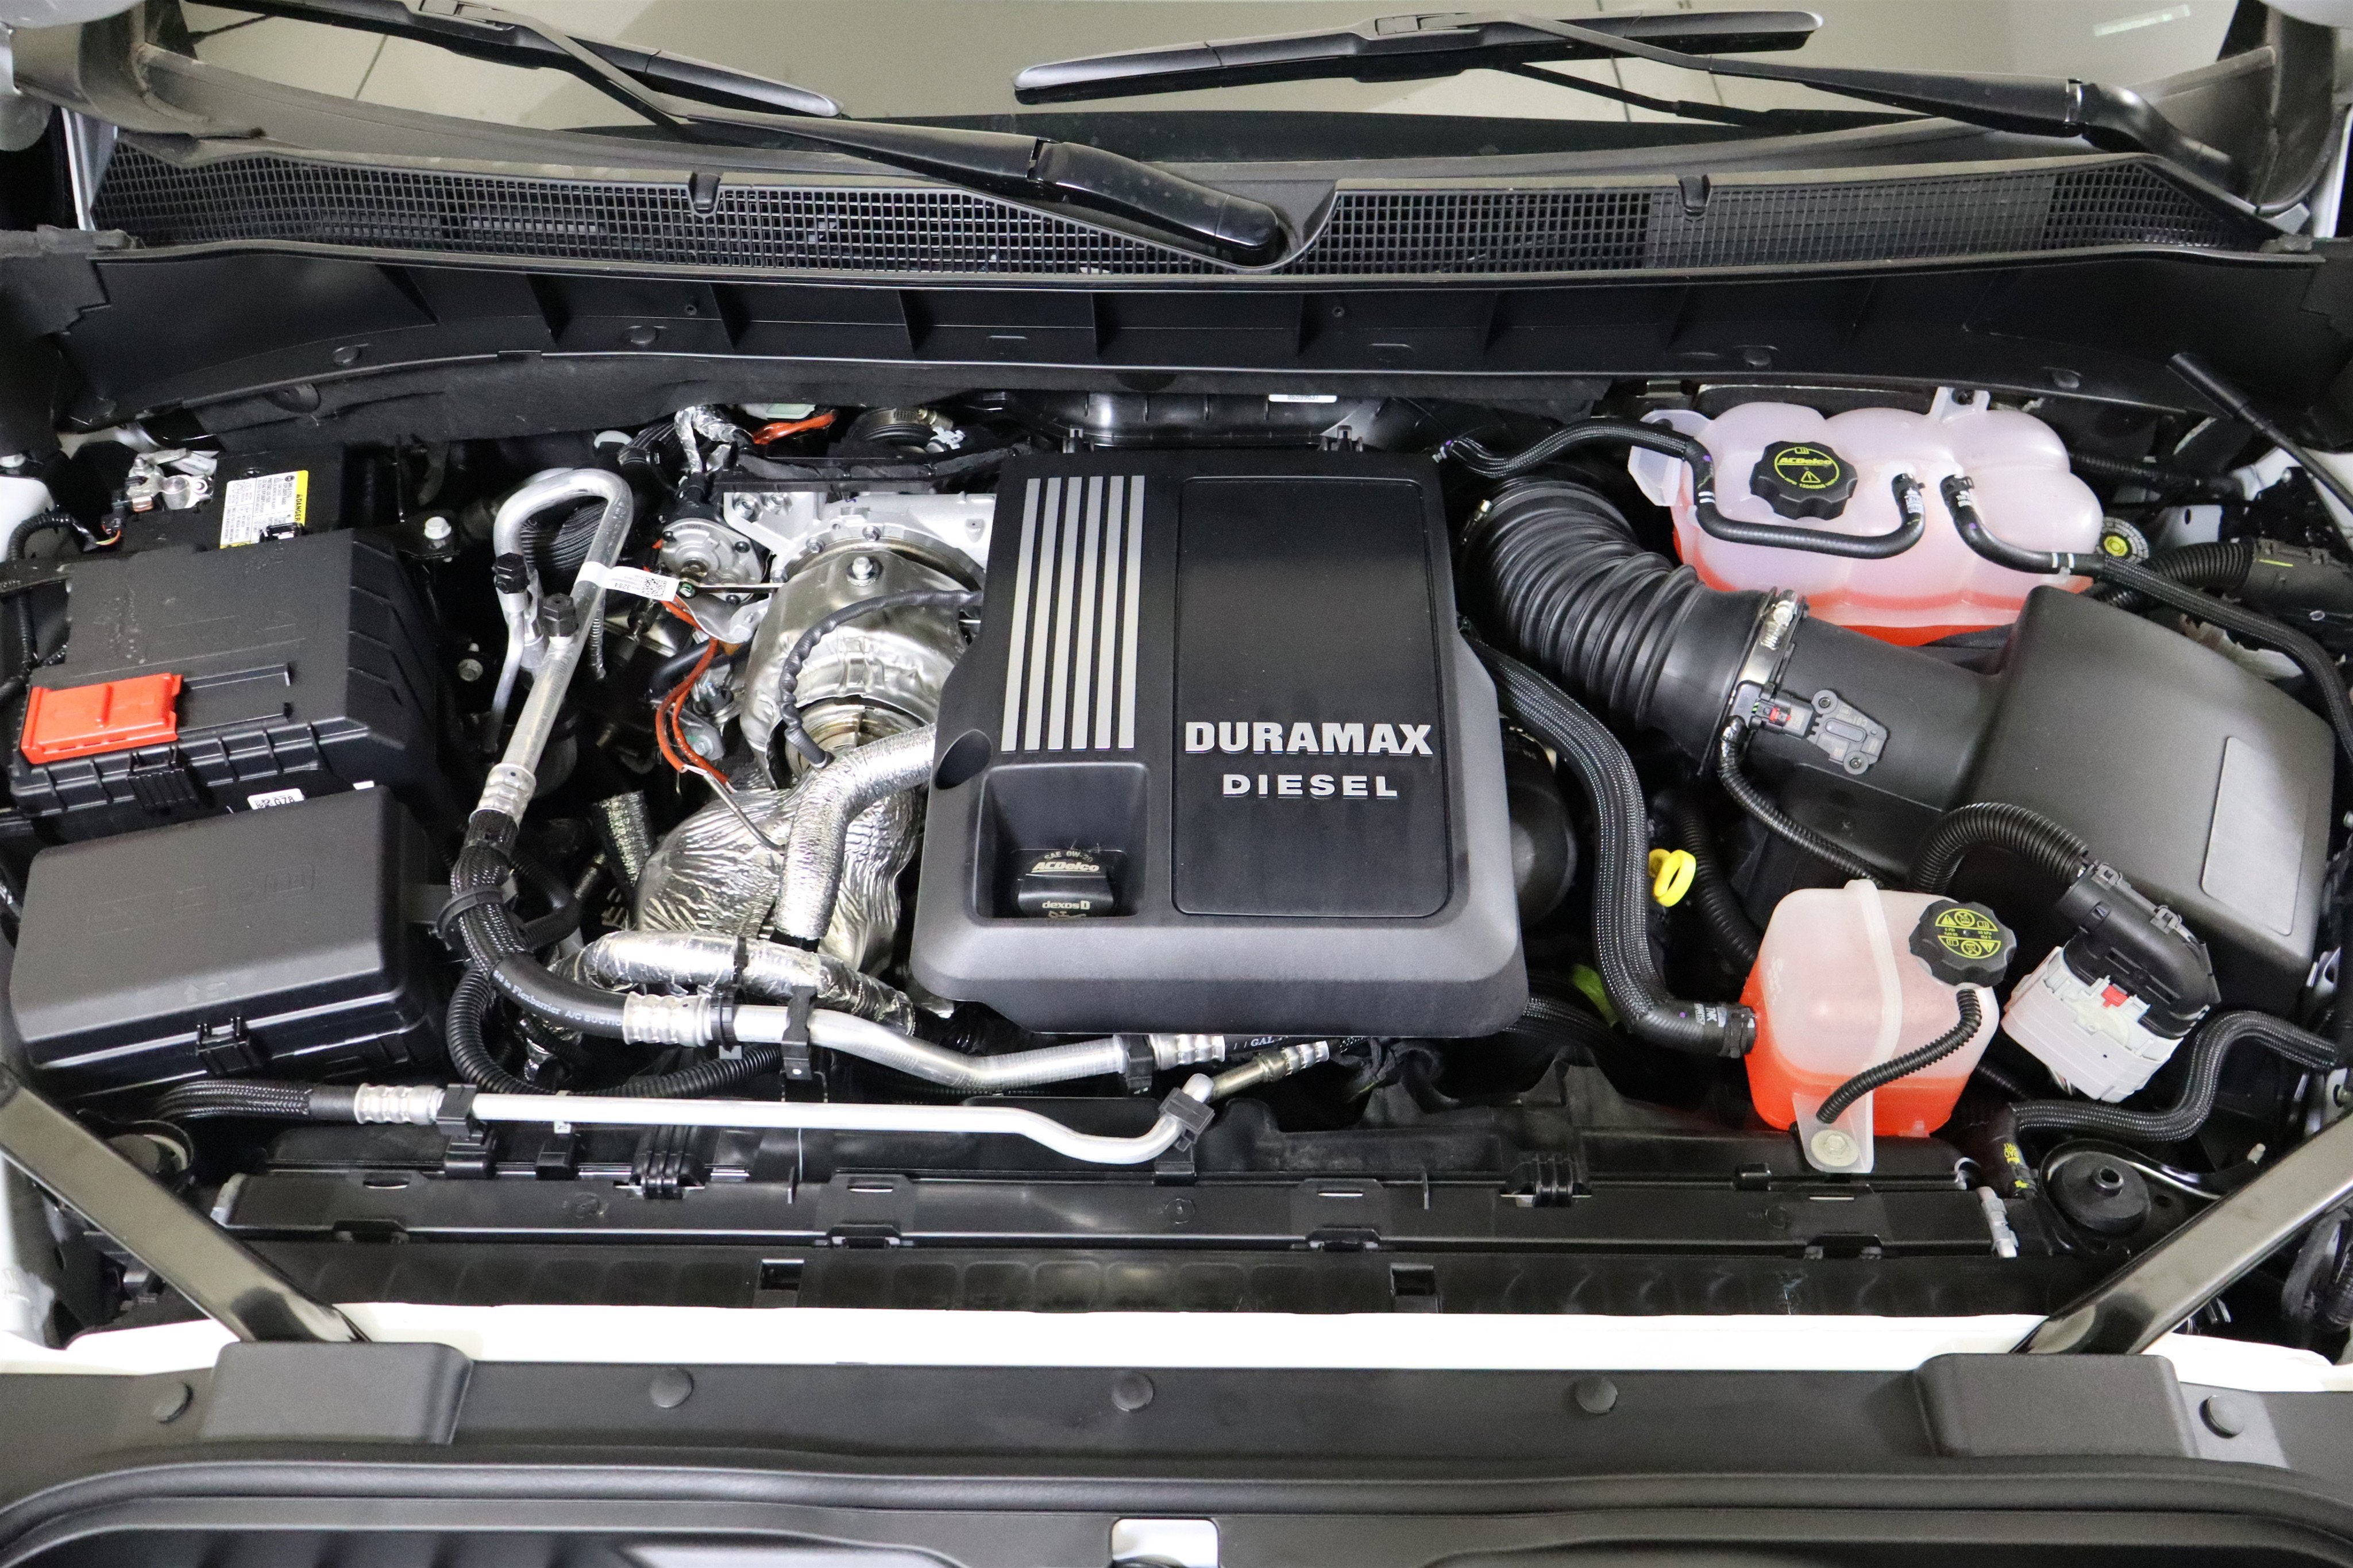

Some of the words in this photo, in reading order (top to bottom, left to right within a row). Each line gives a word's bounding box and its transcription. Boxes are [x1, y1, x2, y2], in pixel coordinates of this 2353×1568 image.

[615, 582, 631, 590] 3284
[1186, 721, 1433, 756] DURAMAX
[1223, 774, 1398, 799] DIESEL
[274, 796, 295, 805] G78
[1044, 851, 1062, 860] SAE
[1066, 851, 1094, 862] 0W-20
[1032, 862, 1100, 872] ACDelco
[511, 984, 561, 1015] Flexbarrier
[565, 1010, 583, 1019] A/C
[1706, 1007, 1717, 1022] TNK
[1251, 1036, 1274, 1046] GAL
